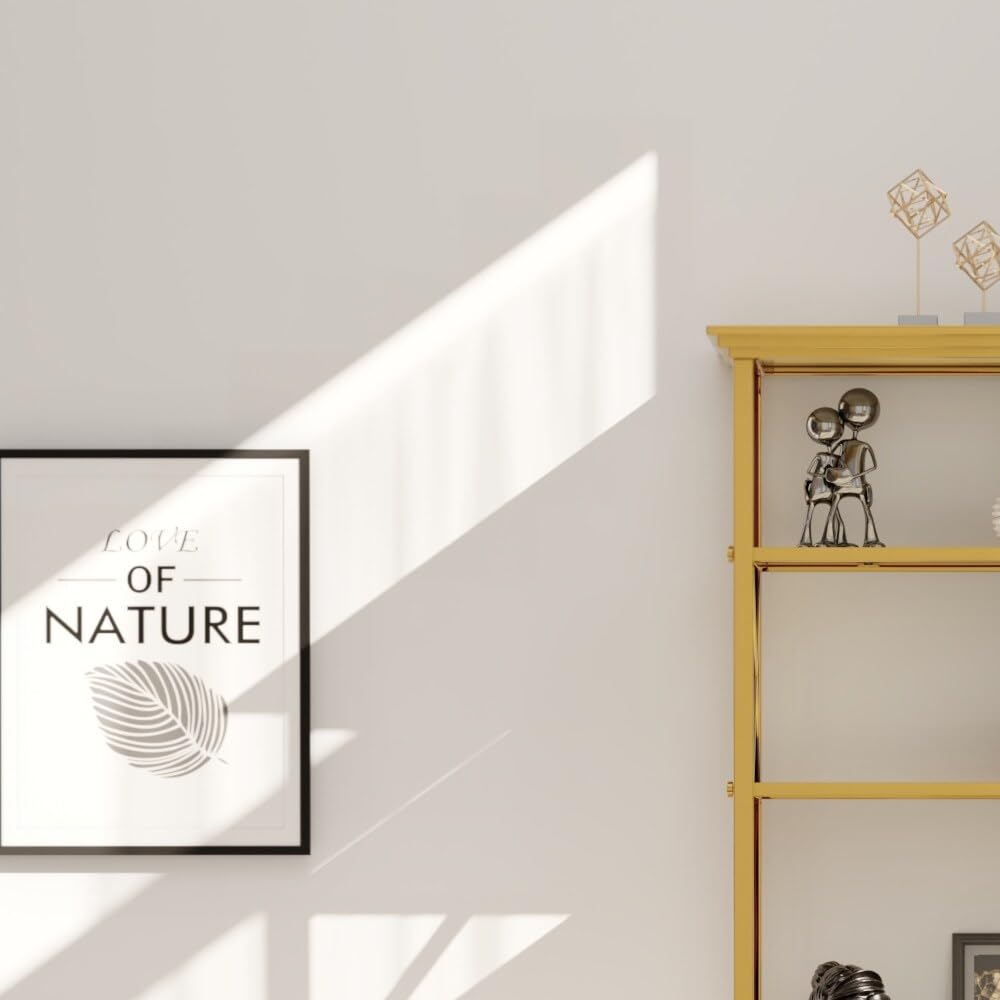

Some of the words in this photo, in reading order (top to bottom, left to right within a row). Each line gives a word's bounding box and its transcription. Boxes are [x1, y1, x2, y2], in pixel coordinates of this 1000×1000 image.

[102, 526, 200, 553] LOVE
[127, 565, 177, 593] OF
[45, 606, 262, 645] NATURE
